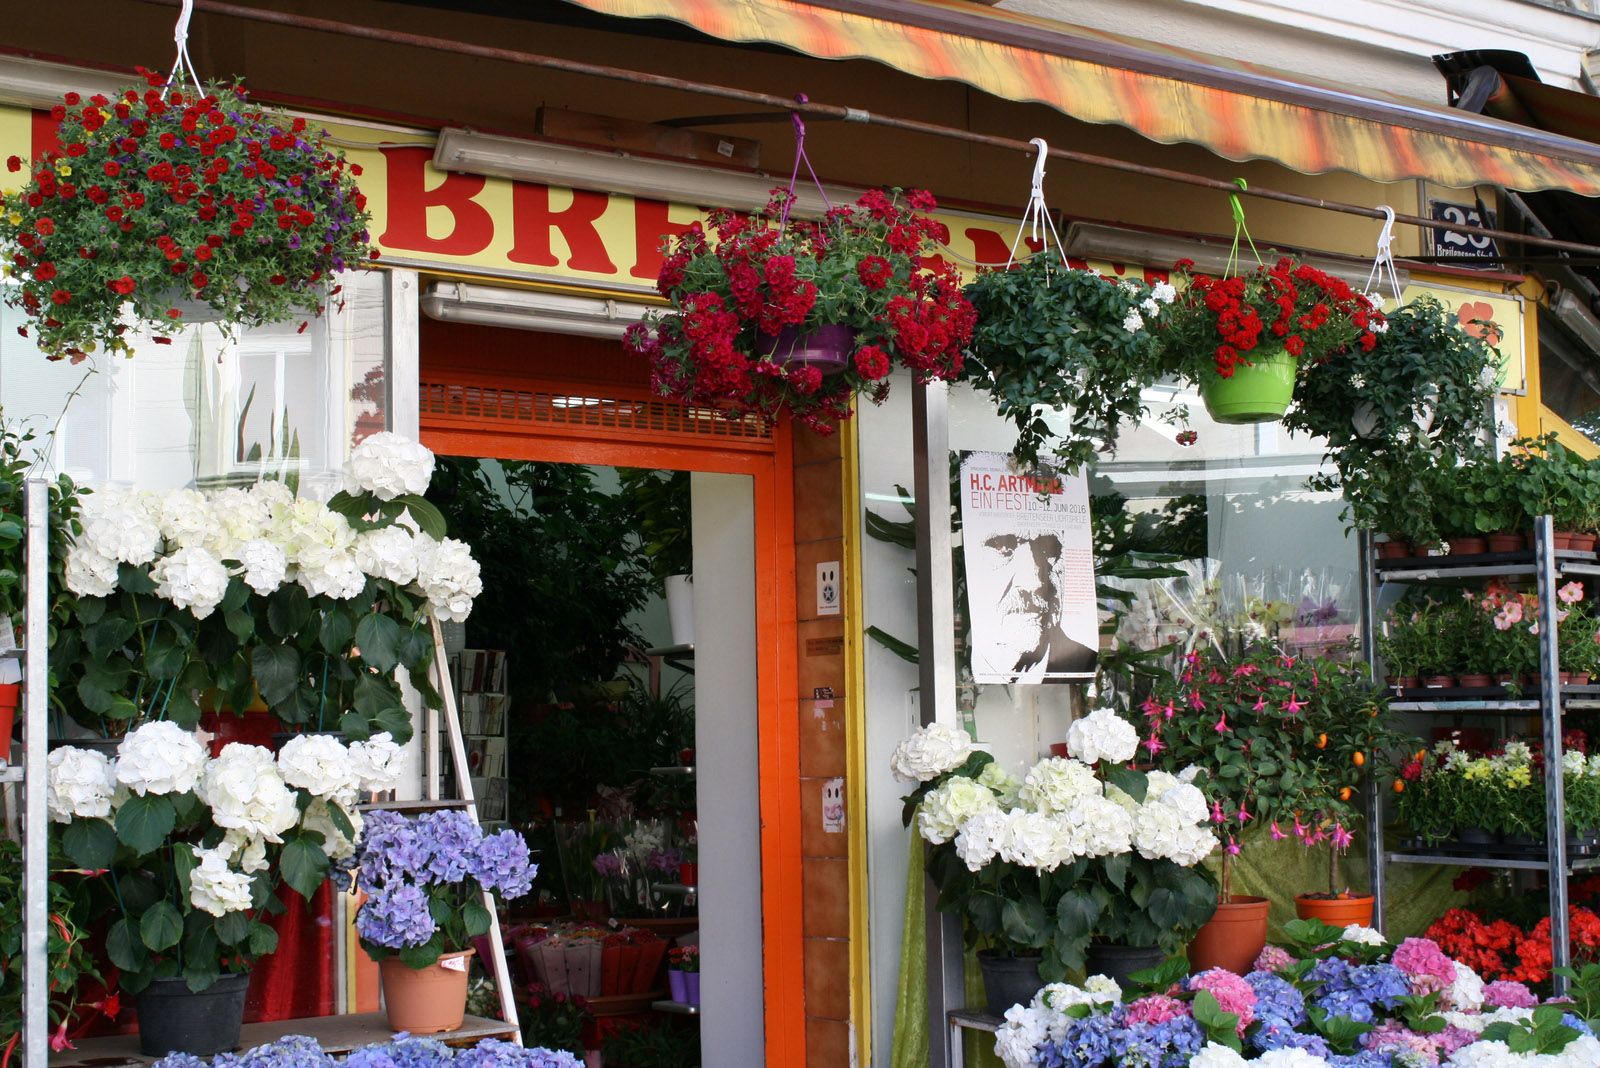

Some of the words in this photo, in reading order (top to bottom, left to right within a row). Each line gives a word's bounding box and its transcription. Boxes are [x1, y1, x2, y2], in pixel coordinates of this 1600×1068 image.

[970, 473, 995, 491] H.C.
[998, 474, 1063, 494] ARTM
[971, 491, 992, 509] EIN
[996, 493, 1029, 512] FEST
[1053, 502, 1068, 513] JUNI
[1069, 504, 1087, 514] 2016
